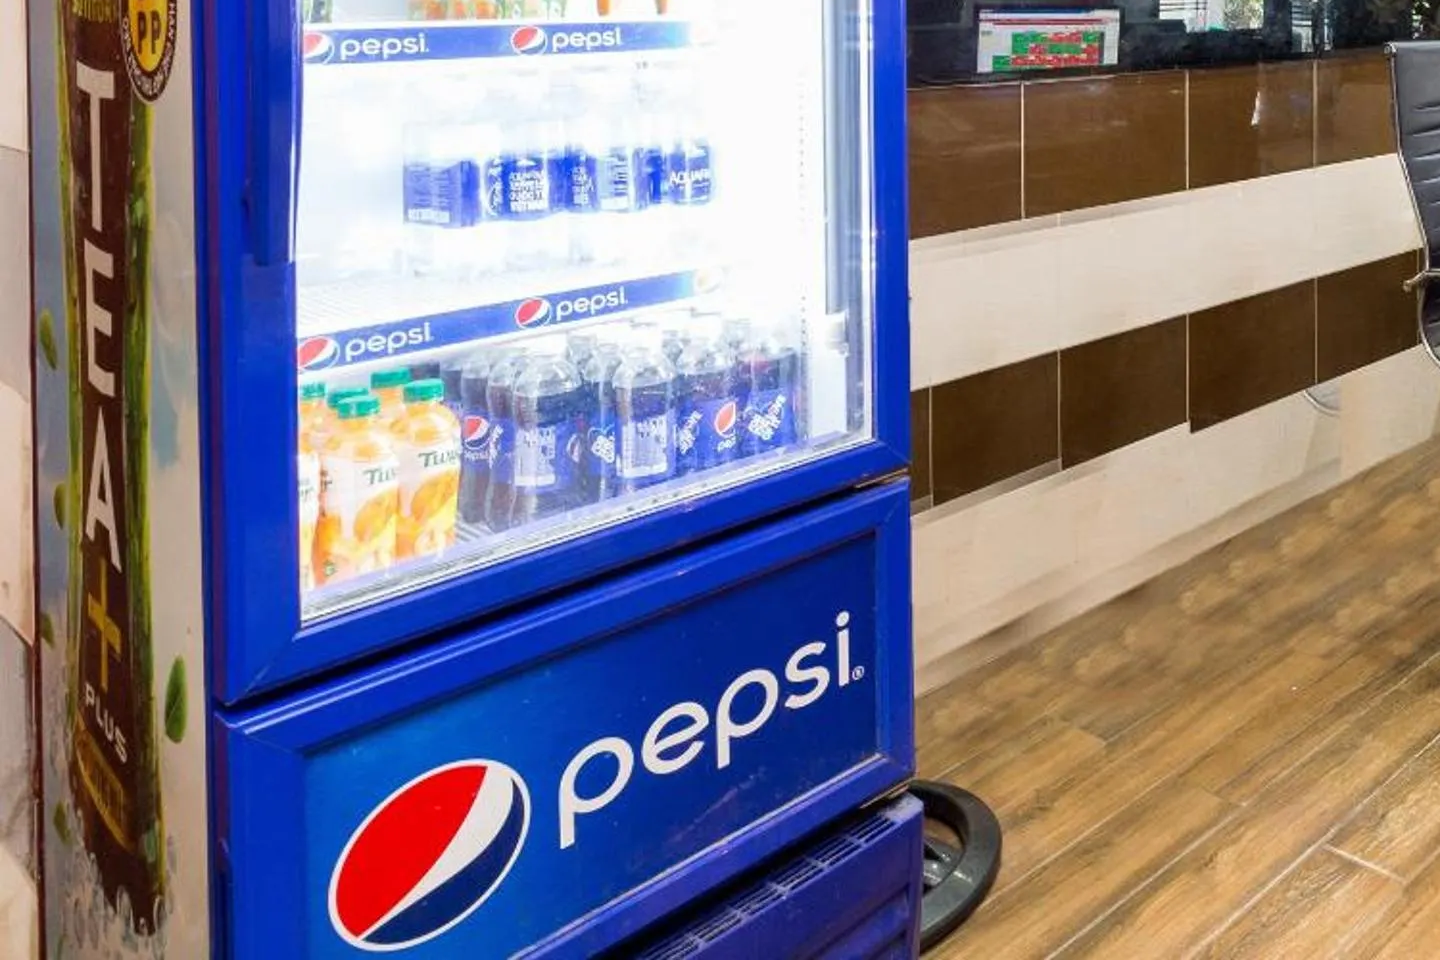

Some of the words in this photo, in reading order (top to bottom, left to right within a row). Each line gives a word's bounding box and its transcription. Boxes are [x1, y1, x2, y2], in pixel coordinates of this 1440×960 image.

[340, 33, 428, 60] pepsi
[552, 28, 623, 54] pepsi
[556, 286, 628, 321] pepsi
[344, 321, 434, 364] pepsi
[84, 683, 129, 764] PLUS
[558, 610, 852, 851] pepsi
